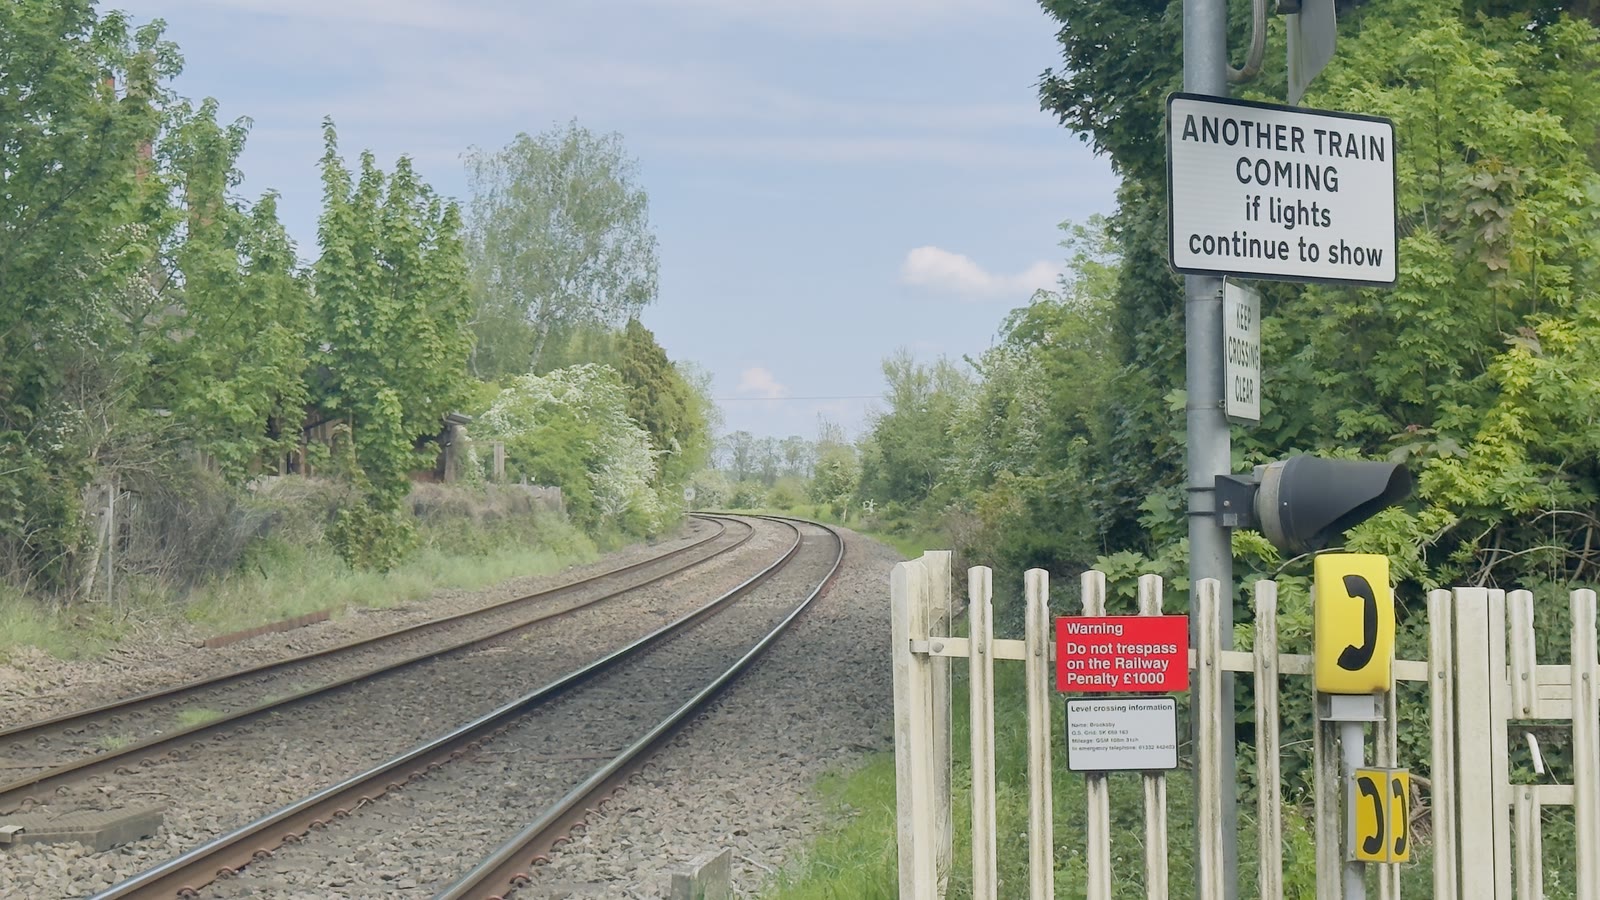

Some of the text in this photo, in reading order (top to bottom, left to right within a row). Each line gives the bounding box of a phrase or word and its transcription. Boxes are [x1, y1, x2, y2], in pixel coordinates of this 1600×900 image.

[1182, 114, 1384, 162] ANOTHER TRAIN
[1236, 156, 1339, 192] COMING
[1246, 195, 1331, 230] if lights
[1189, 231, 1383, 267] continue to show
[1236, 302, 1251, 332] KEEP
[1228, 336, 1259, 370] CROSSING
[1235, 375, 1254, 404] CLEAR
[1067, 622, 1124, 636] Warning
[1067, 642, 1177, 656] Do not trespass
[1067, 657, 1168, 672] on the Railway
[1067, 672, 1164, 687] Penalty £1000
[1094, 704, 1126, 713] crossing
